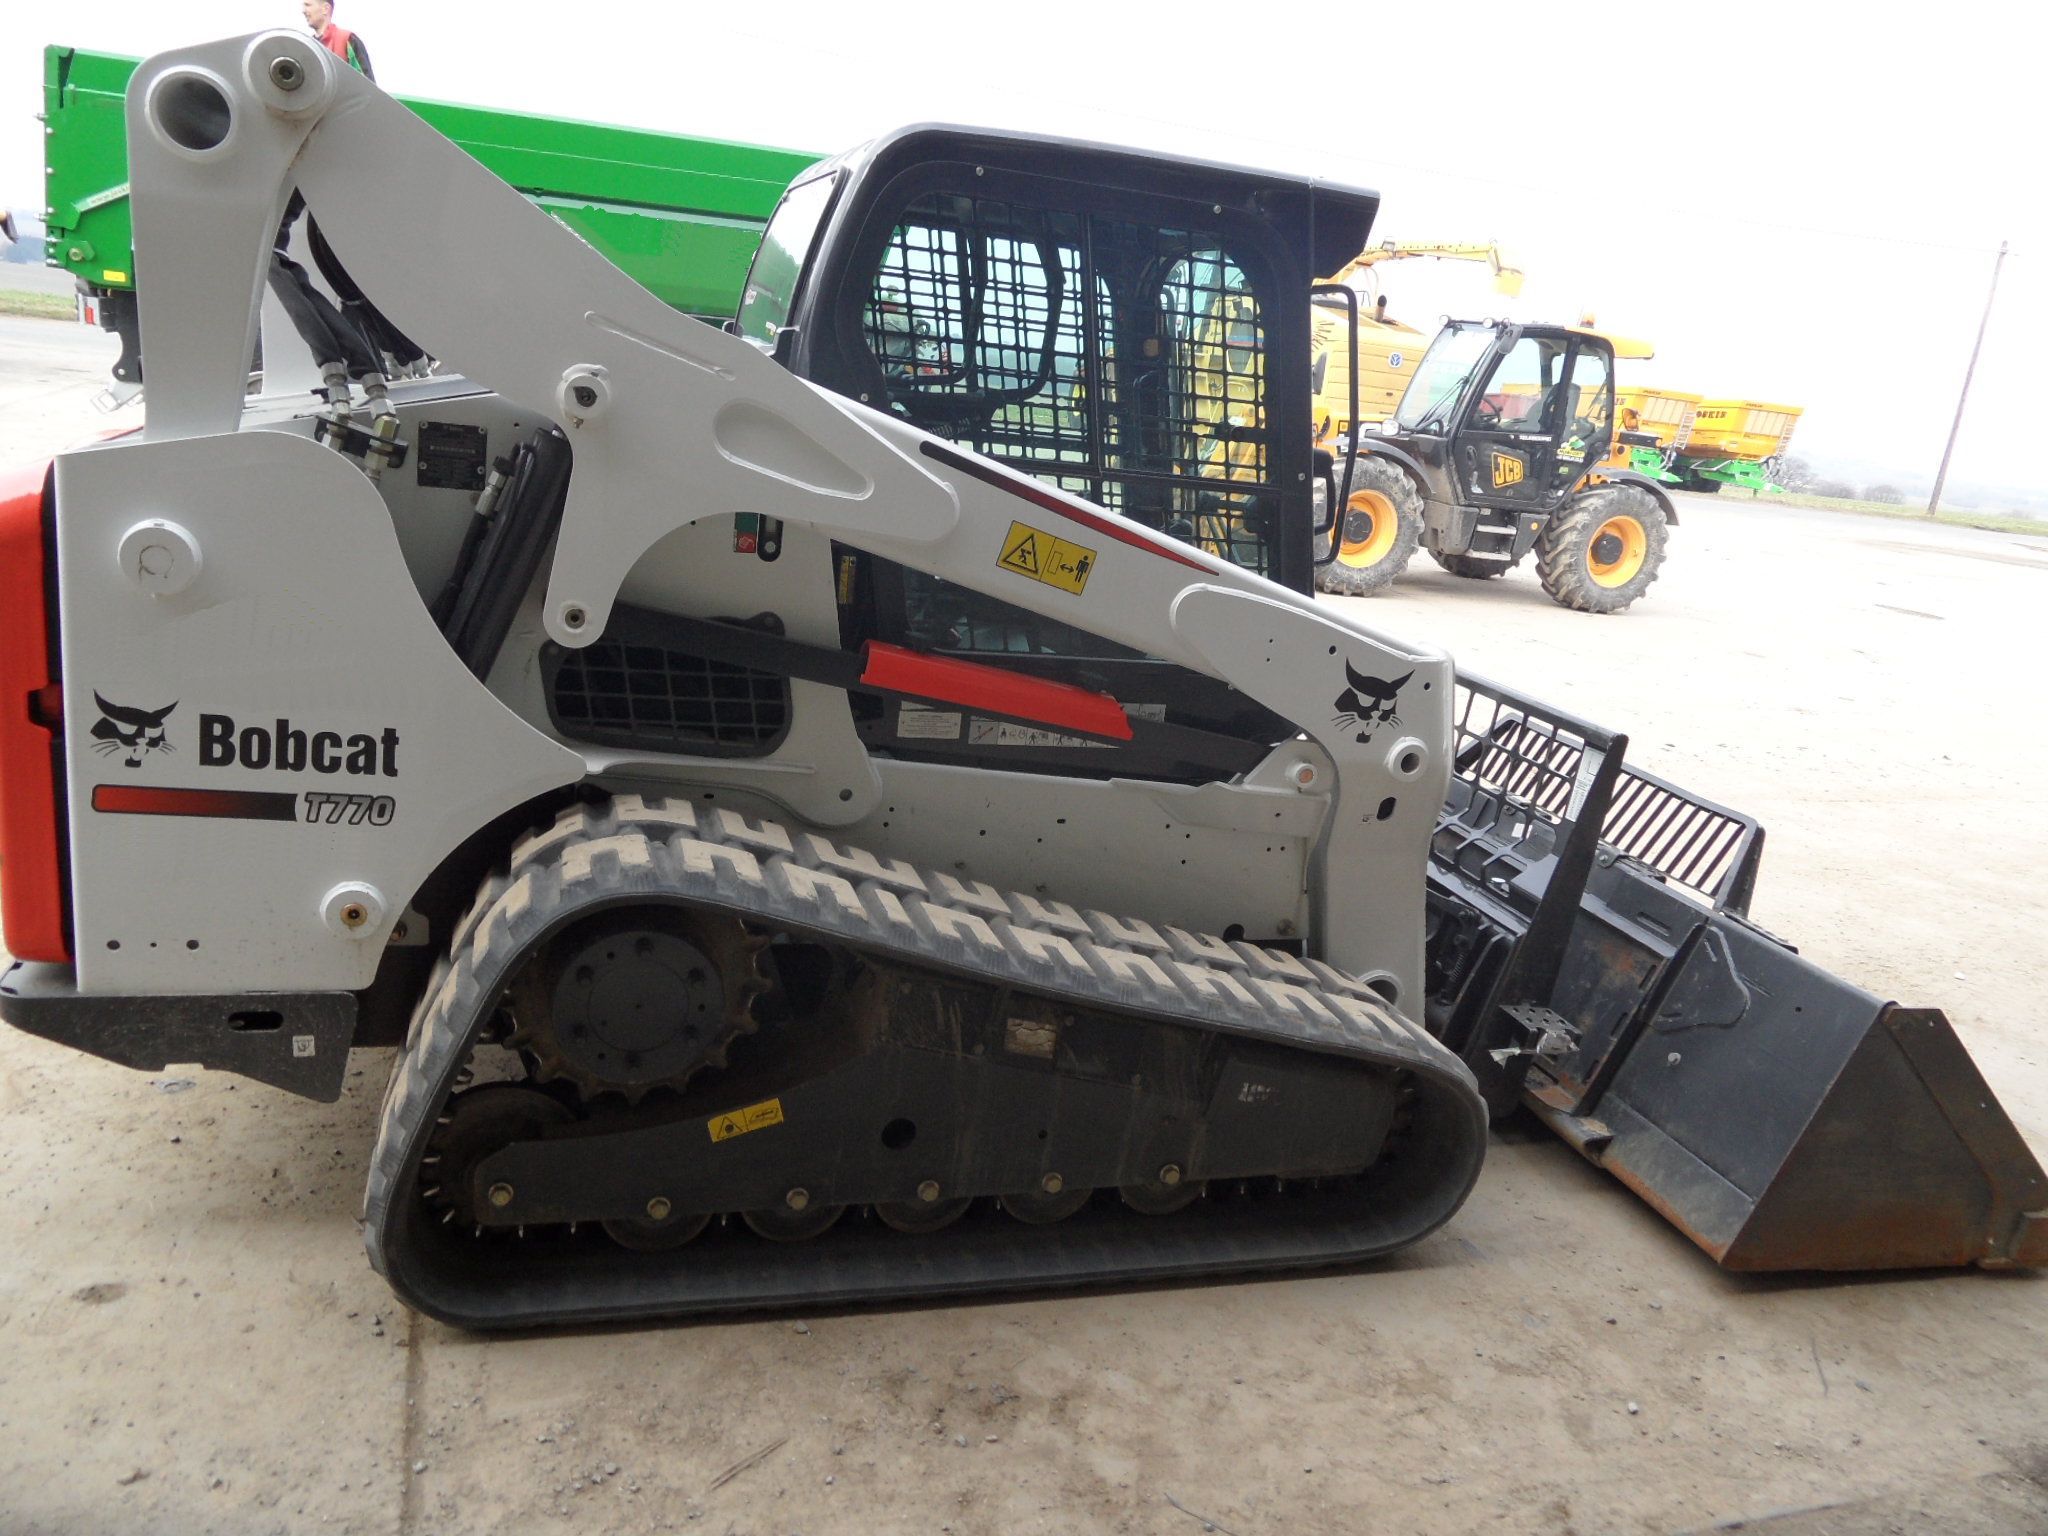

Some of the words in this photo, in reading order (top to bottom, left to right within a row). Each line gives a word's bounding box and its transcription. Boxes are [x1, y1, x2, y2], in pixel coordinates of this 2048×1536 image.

[1495, 456, 1521, 484] JCB
[199, 713, 399, 777] Bobcat
[304, 791, 396, 826] T770
